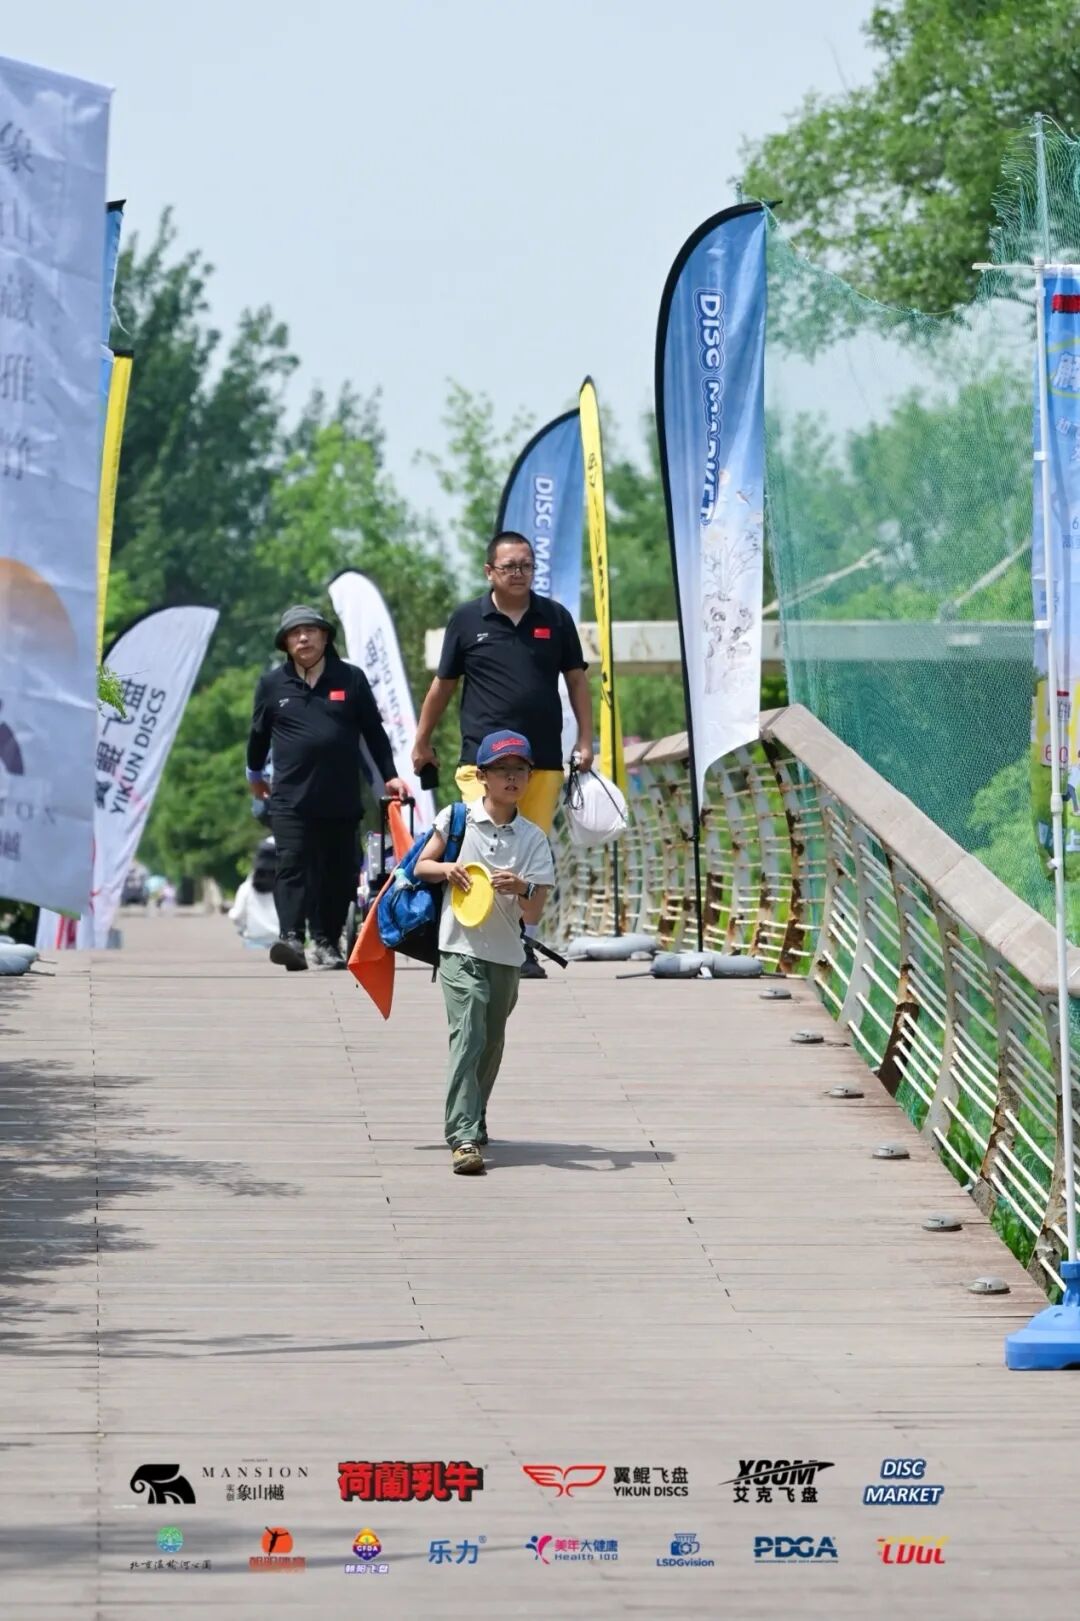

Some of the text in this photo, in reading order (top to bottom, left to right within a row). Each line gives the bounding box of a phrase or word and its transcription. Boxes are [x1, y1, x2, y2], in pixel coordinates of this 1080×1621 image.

[699, 293, 721, 370] DISC
[534, 477, 553, 530] DISC
[109, 687, 167, 815] YIKUN DISCS
